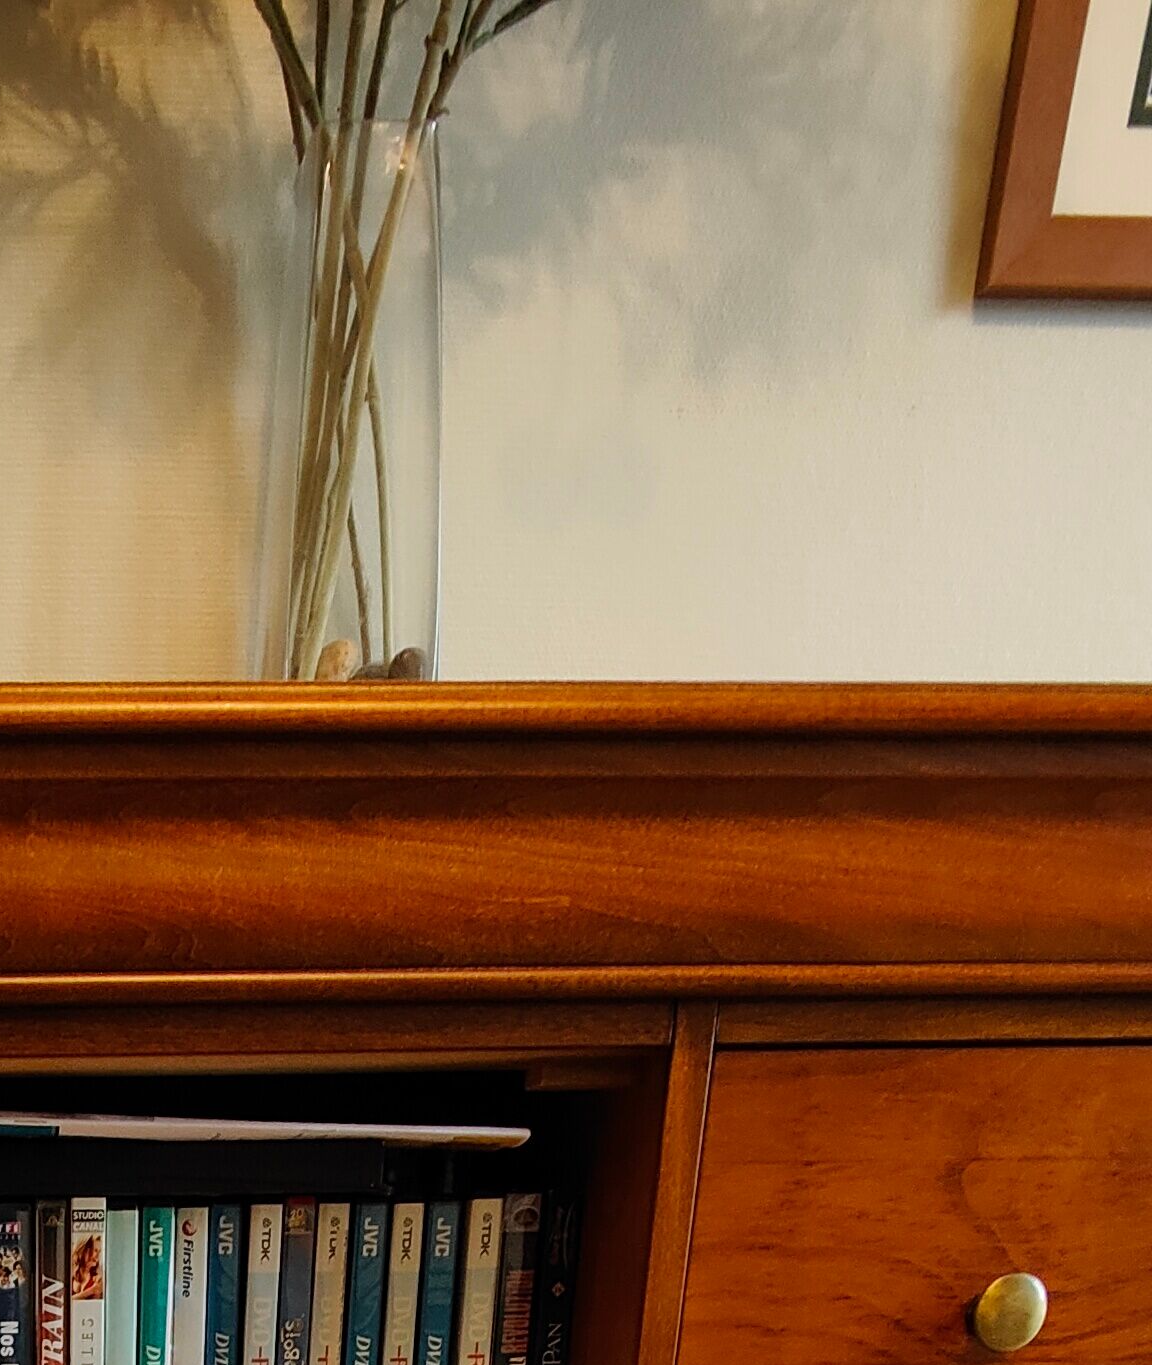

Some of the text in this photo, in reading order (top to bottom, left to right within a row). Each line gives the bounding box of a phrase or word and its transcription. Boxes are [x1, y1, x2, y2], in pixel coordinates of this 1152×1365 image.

[72, 1211, 105, 1220] STUDIO
[72, 1221, 105, 1232] CANAL
[149, 1219, 164, 1258] JVC
[217, 1215, 234, 1255] JVC
[260, 1229, 272, 1265] TDK
[361, 1216, 379, 1257] JVC
[400, 1227, 414, 1263] TDK
[434, 1216, 452, 1257] JVC
[480, 1223, 493, 1259] TDK
[181, 1239, 194, 1299] Firstline
[0, 1320, 19, 1357] Nos
